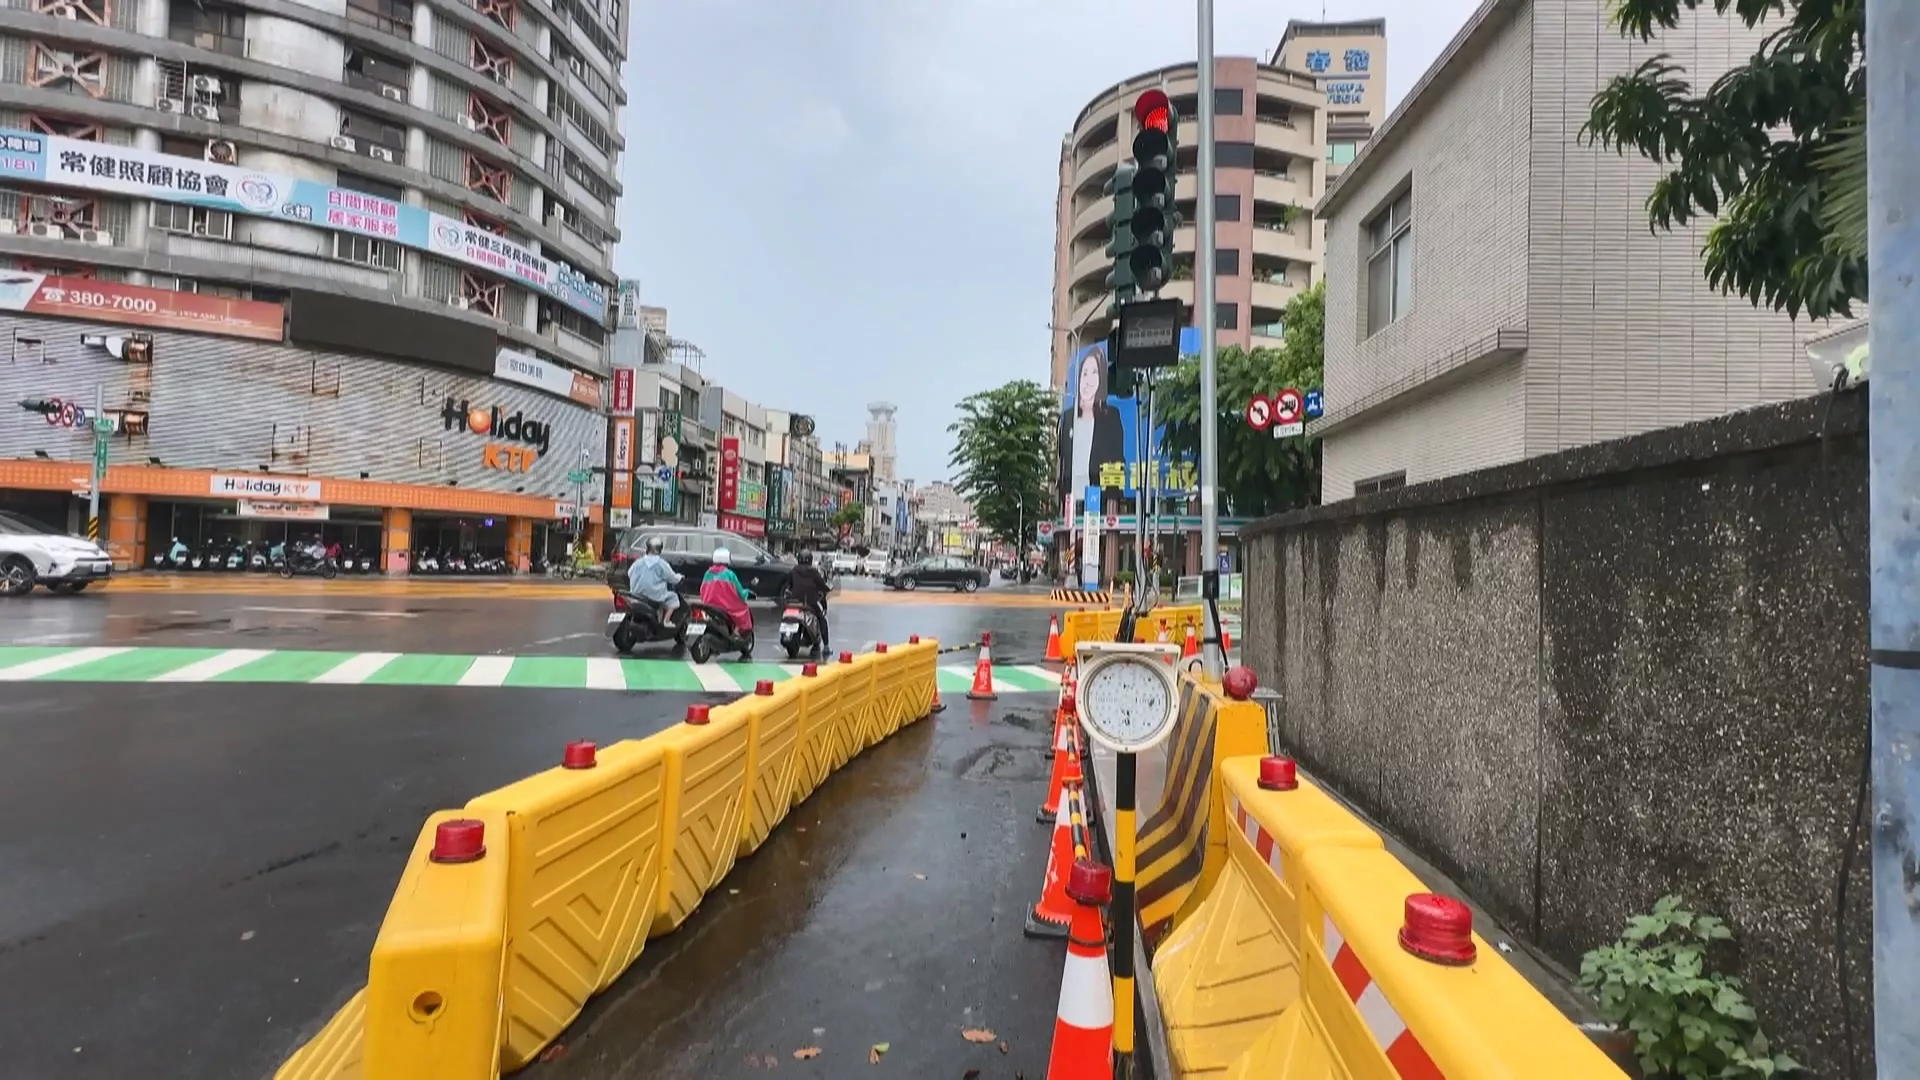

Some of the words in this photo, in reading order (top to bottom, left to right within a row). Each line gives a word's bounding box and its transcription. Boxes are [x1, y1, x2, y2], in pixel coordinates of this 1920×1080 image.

[60, 150, 230, 197] 常健照顧協會
[328, 190, 398, 220] 日間照顧
[69, 290, 157, 313] 380-7000
[441, 397, 550, 457] Holiday
[483, 443, 538, 473] KTV
[225, 478, 281, 496] Holiday
[284, 485, 308, 494] KTV
